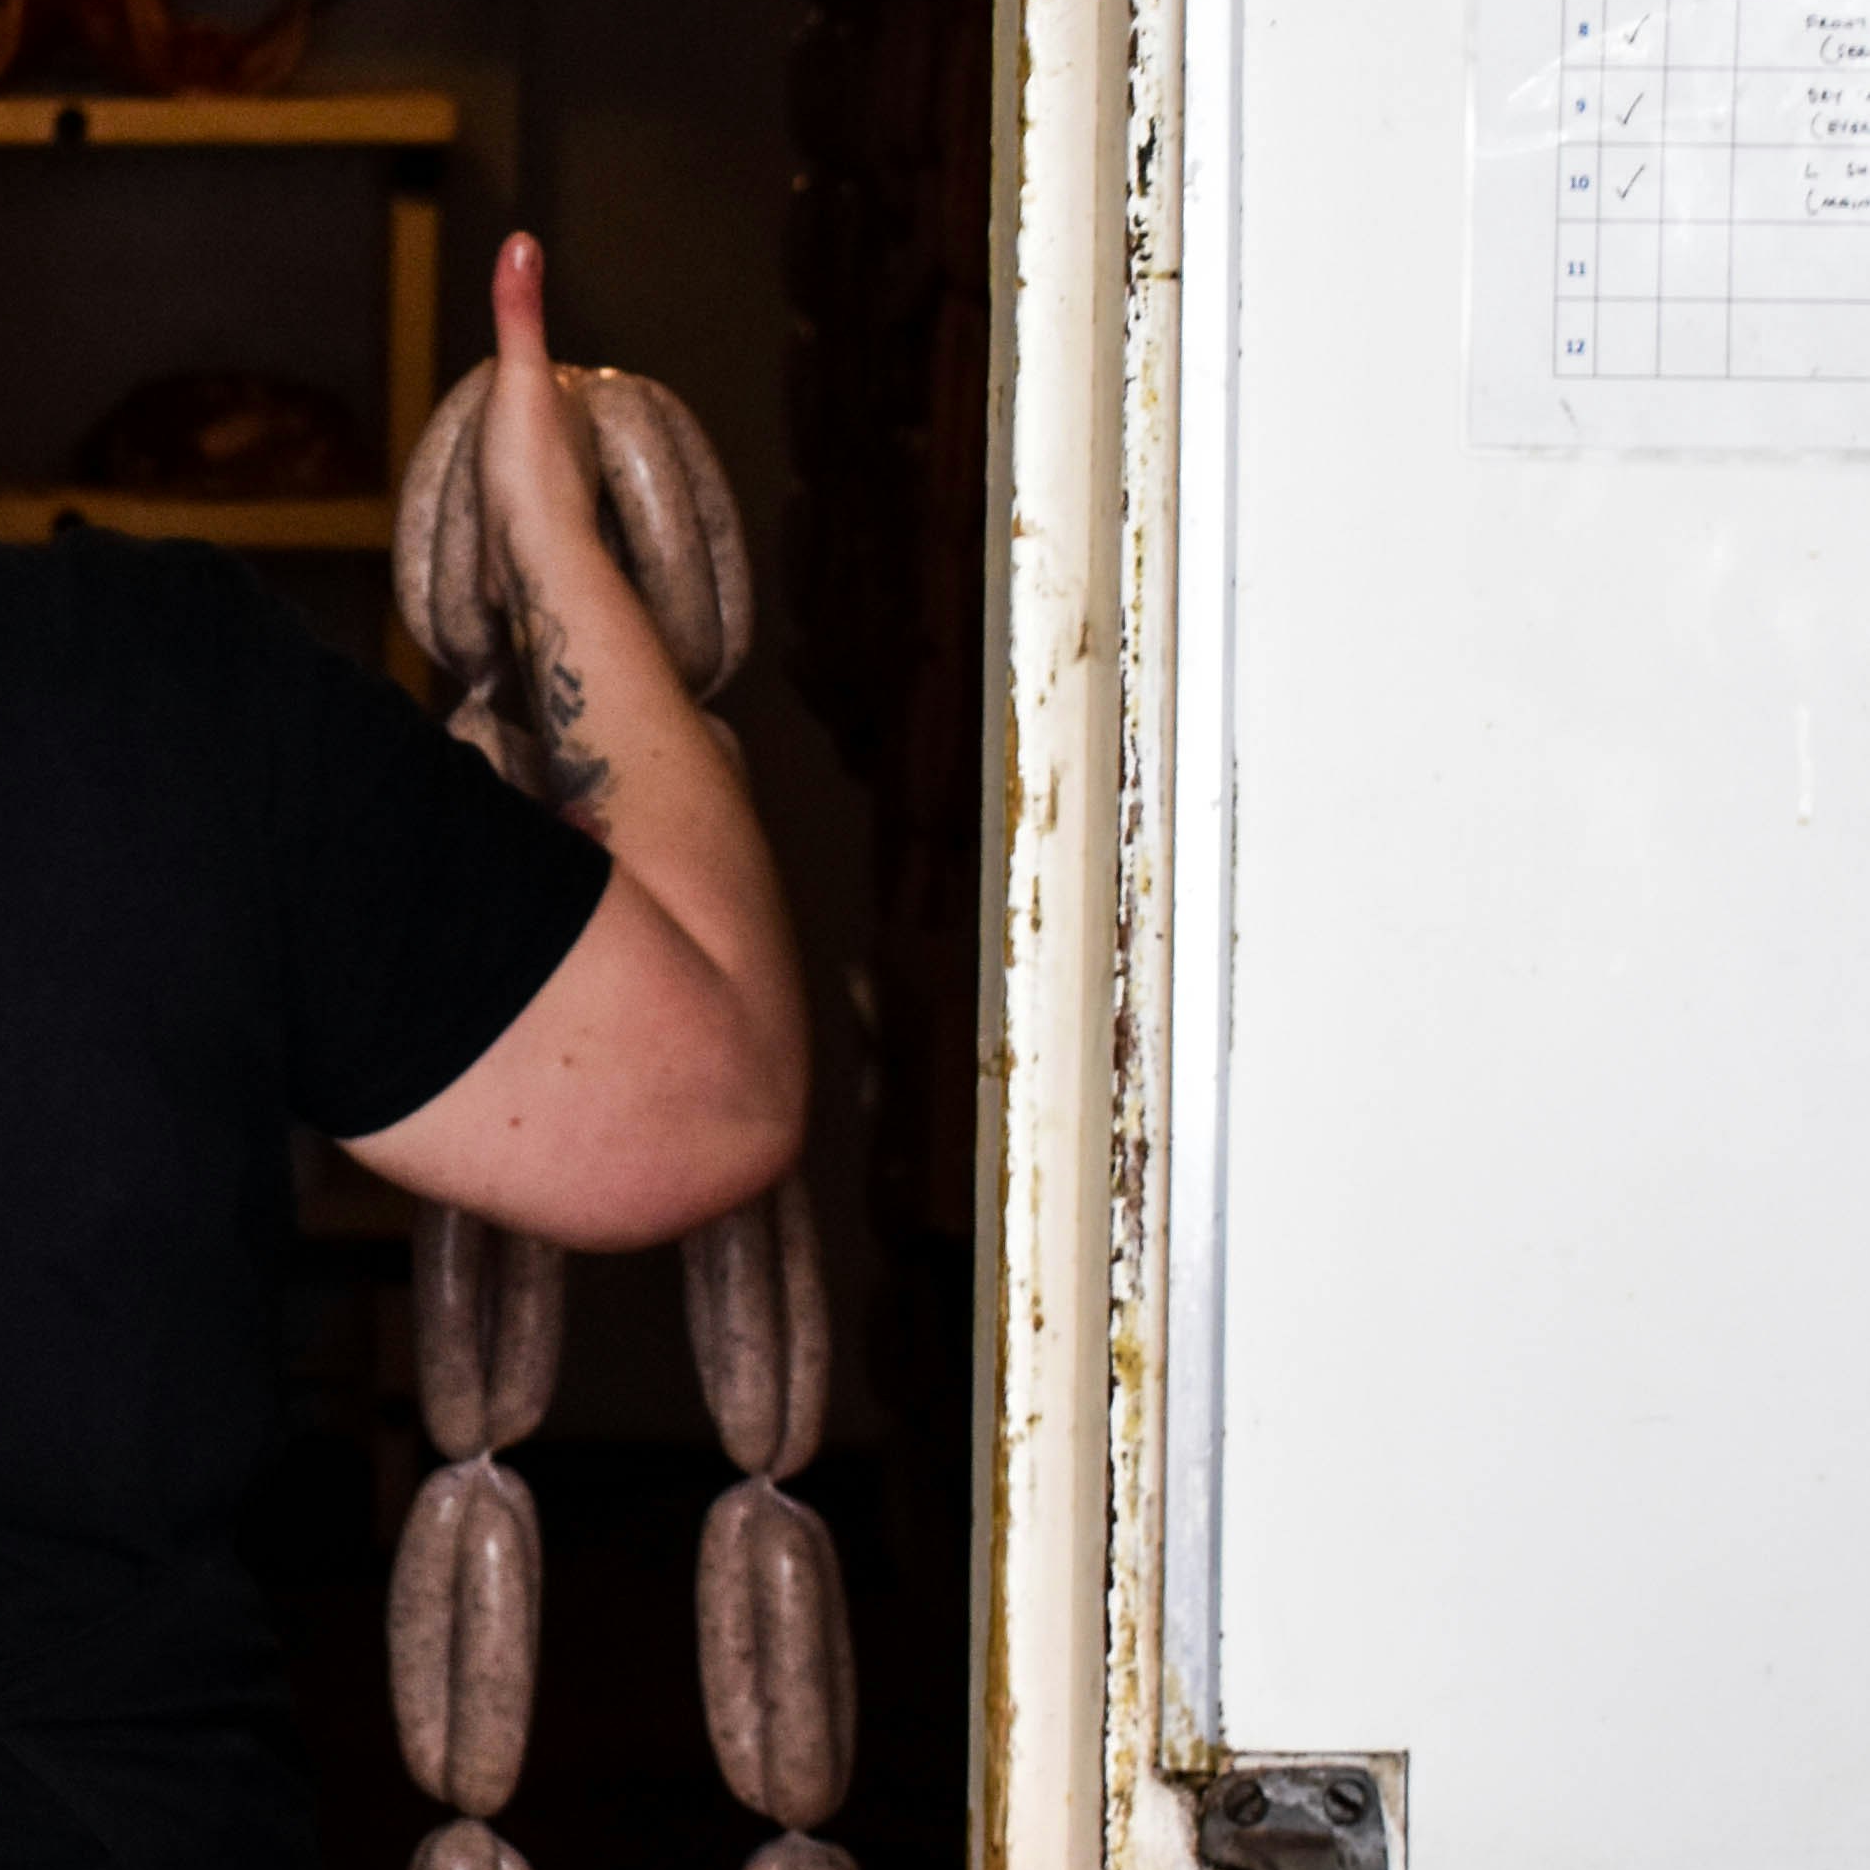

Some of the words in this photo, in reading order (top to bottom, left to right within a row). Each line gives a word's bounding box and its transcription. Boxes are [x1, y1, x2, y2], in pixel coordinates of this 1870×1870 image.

[1578, 22, 1590, 37] 8
[1576, 99, 1587, 114] 9
[1569, 175, 1590, 191] 10
[1567, 261, 1587, 276] 11
[1566, 339, 1586, 355] 12
